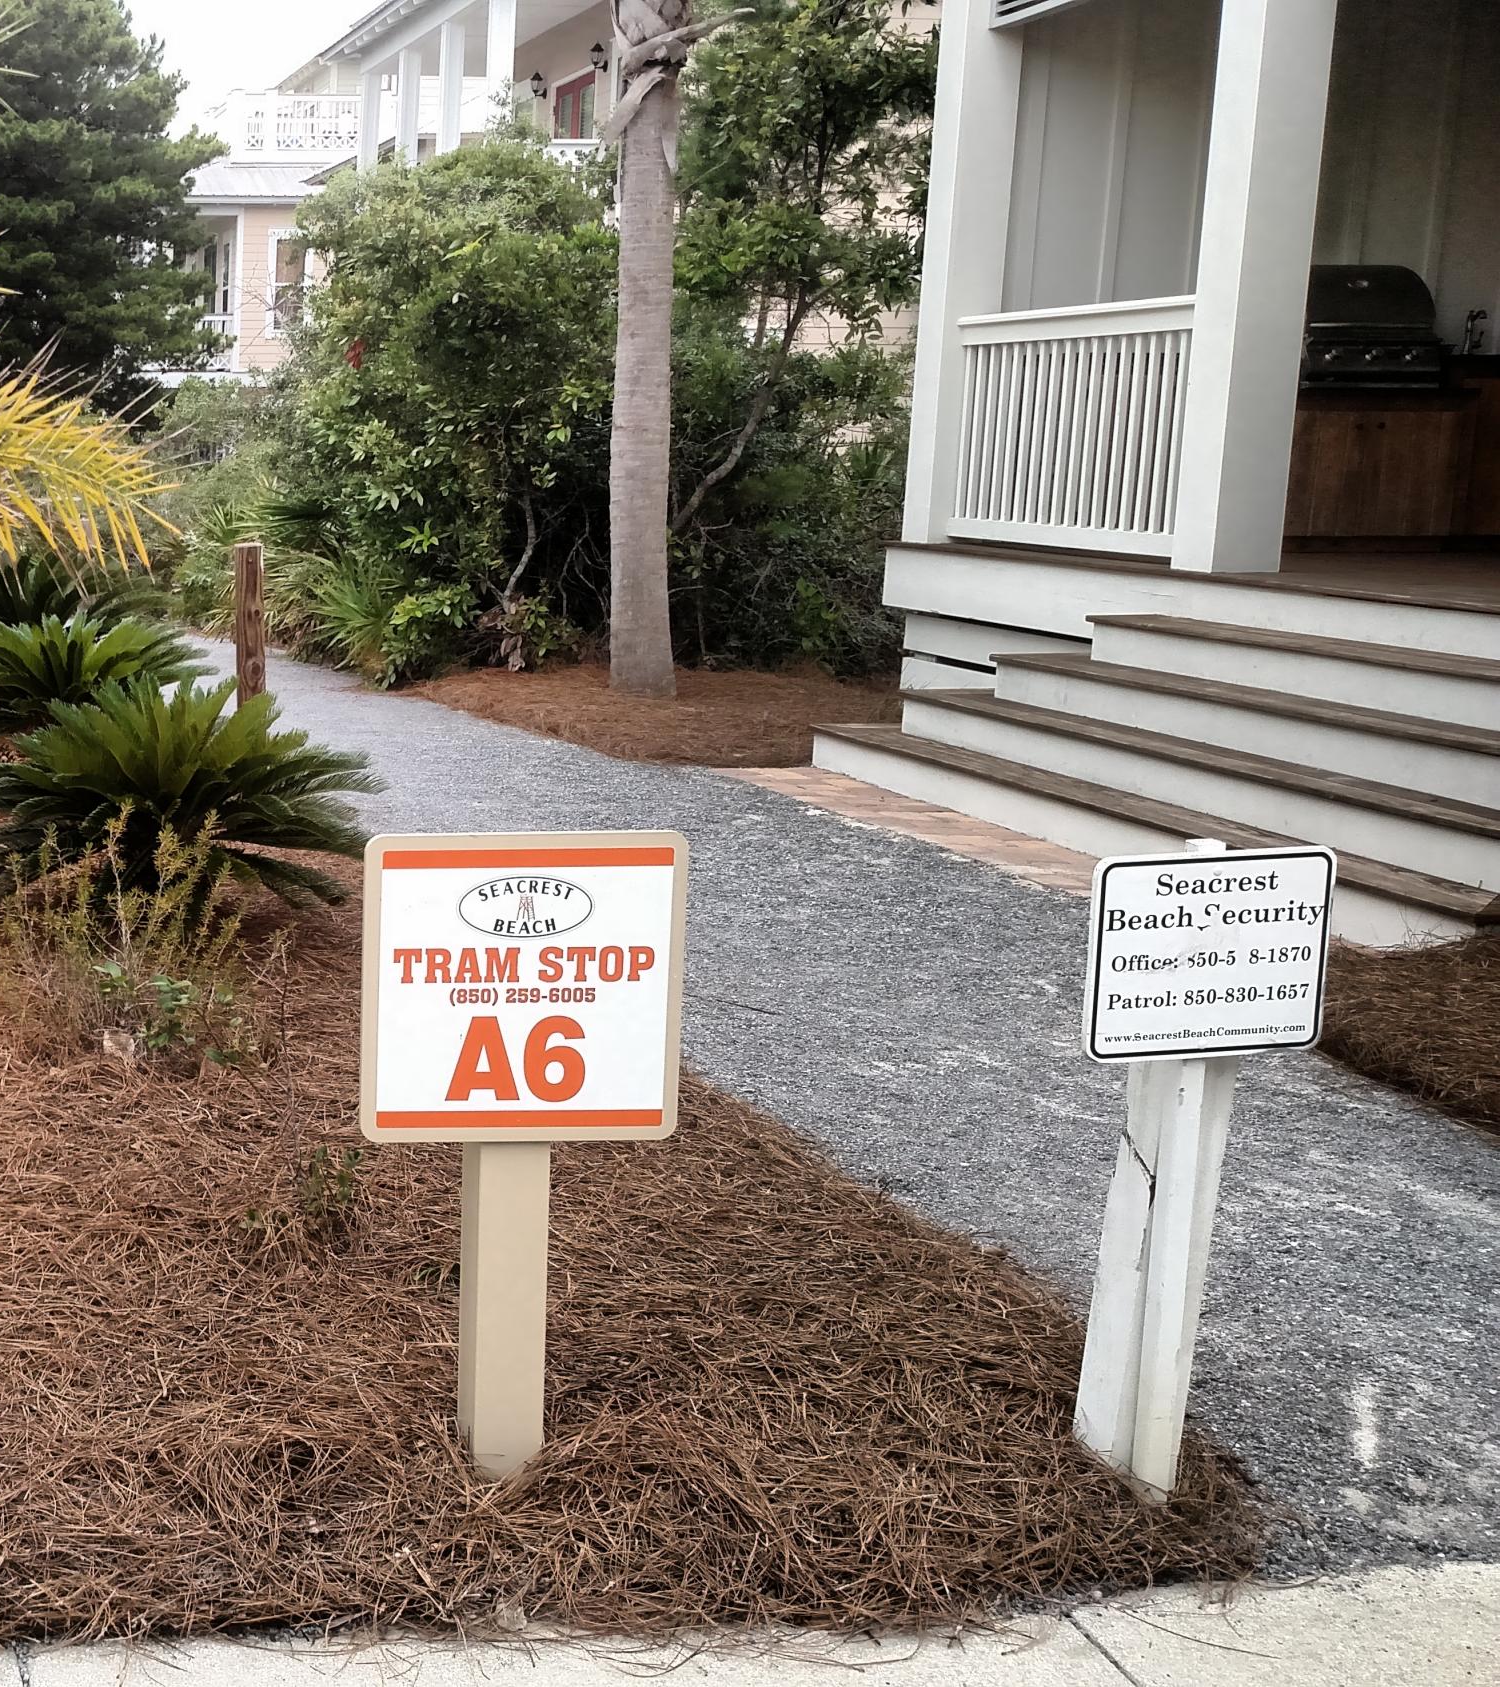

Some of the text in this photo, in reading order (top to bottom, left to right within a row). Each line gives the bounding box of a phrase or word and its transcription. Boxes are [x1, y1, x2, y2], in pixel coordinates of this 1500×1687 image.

[478, 880, 574, 902] SEACREST
[1155, 871, 1279, 896] Seacrest
[493, 918, 557, 935] BEACH
[1106, 906, 1194, 932] Beach
[393, 946, 655, 983] TRAM STOP
[1111, 946, 1312, 972] Office: 850-58-1870
[449, 987, 596, 1006] (850) 259-6005
[1107, 984, 1309, 1010] Patrol: 850-830-1657
[1104, 1024, 1306, 1043] www.SeacrestBeachCommunity.com
[445, 1015, 586, 1102] A6
